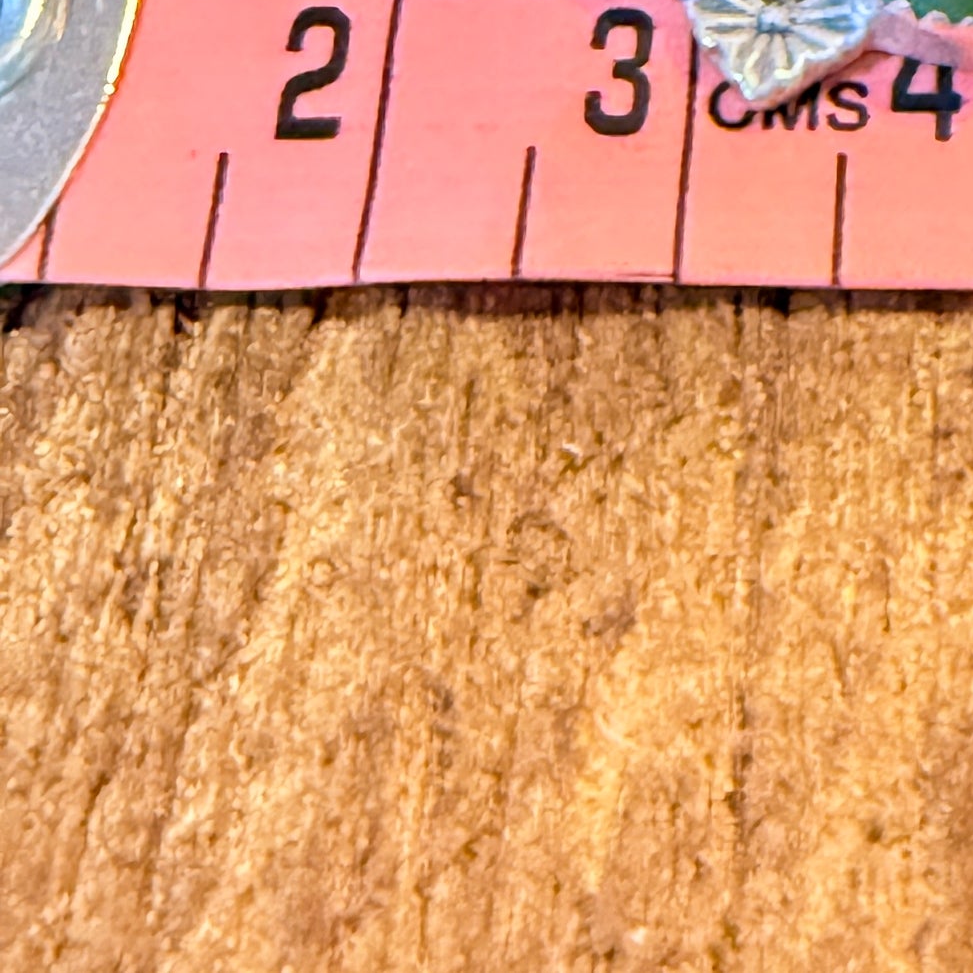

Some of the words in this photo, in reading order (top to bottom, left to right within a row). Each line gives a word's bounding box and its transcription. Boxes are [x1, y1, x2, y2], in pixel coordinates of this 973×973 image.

[274, 6, 350, 140] 2
[585, 8, 654, 136] 3
[891, 55, 963, 142] 4
